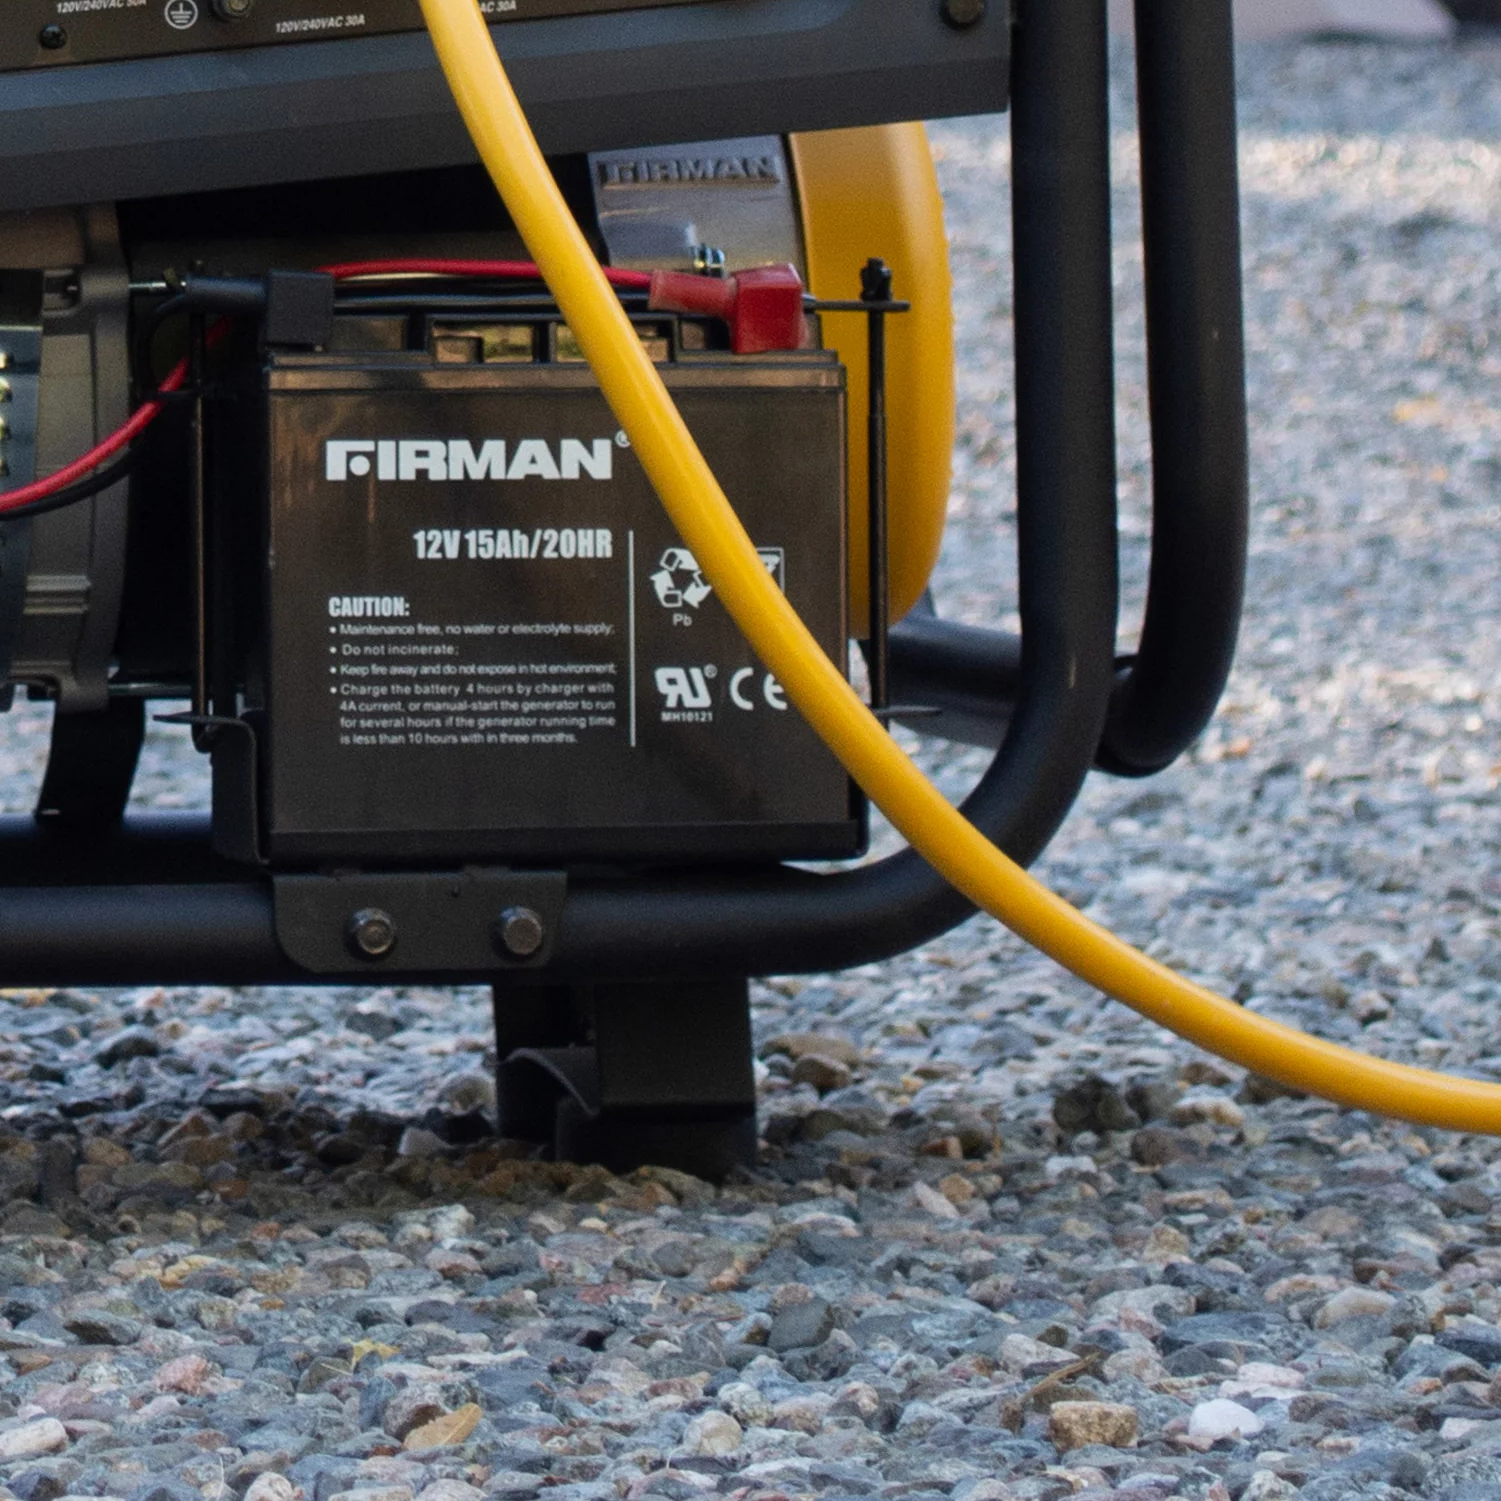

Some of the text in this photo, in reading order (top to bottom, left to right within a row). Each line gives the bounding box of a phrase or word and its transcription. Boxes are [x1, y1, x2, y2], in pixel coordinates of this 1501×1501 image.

[496, 0, 517, 12] 30A
[275, 14, 365, 33] 120V/240VAC 30A
[604, 156, 780, 184] FIRMAN
[326, 439, 613, 481] FIRMAN
[413, 529, 613, 559] 12V 15Ah/20HR
[328, 596, 410, 617] CAUTION:
[672, 614, 692, 626] Pb
[340, 623, 415, 635] Maintenance
[417, 623, 443, 636] free,
[445, 625, 461, 634] no
[463, 624, 495, 634] water
[497, 625, 510, 634] or
[511, 623, 572, 636] electrolyte
[342, 643, 361, 655] Do
[363, 643, 385, 655] not
[340, 664, 369, 677] Keep
[371, 663, 387, 675] fire
[389, 665, 418, 678] away
[420, 664, 441, 675] and
[442, 664, 457, 675] do
[458, 664, 476, 675] not
[477, 665, 517, 676] expose
[518, 664, 529, 675] in
[530, 664, 547, 675] hot
[340, 683, 615, 698] Charge the battery 4 hours by charger with
[340, 701, 357, 712] 4A
[408, 702, 421, 712] or
[500, 700, 519, 711] the
[521, 700, 579, 714] generator
[581, 700, 594, 710] to
[595, 700, 616, 710] run
[340, 716, 616, 730] for several hours if the generator running time
[340, 733, 351, 744] is
[352, 733, 377, 744] less
[378, 733, 405, 744] than
[408, 733, 423, 744] 10
[424, 733, 458, 744] hours
[460, 733, 484, 744] with
[486, 733, 498, 744] in
[499, 733, 530, 744] three
